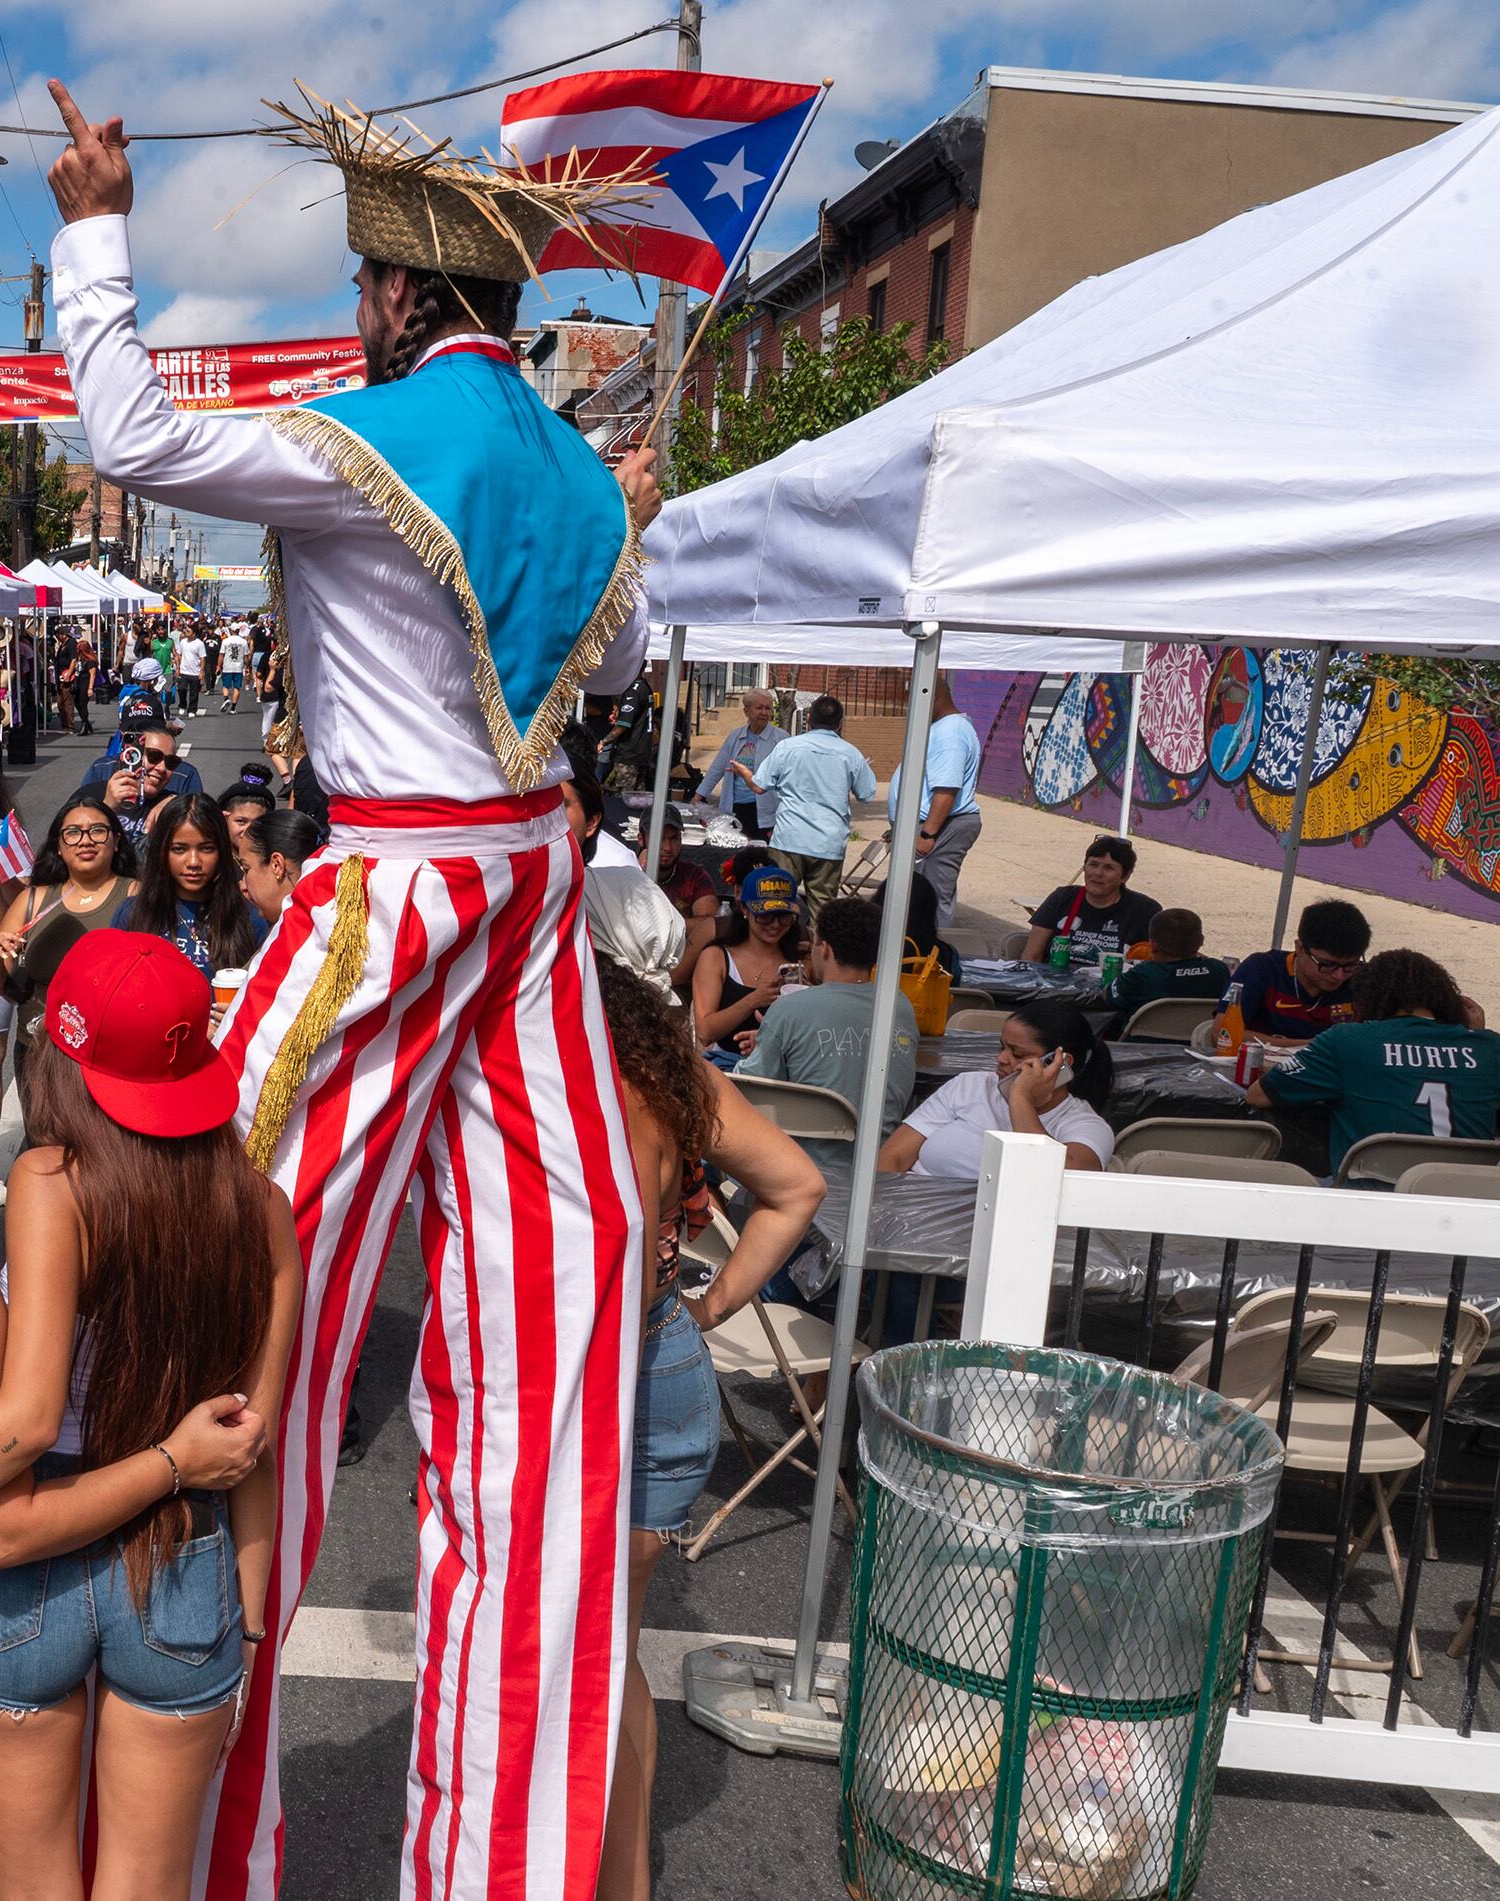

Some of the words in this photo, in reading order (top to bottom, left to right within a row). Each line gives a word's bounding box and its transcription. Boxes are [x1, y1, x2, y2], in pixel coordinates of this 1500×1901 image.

[156, 351, 202, 374] ARTE
[252, 354, 276, 364] FREE
[278, 351, 331, 363] Community
[205, 364, 215, 373] EN
[217, 362, 231, 372] LAS
[161, 373, 231, 400] CALLES
[14, 396, 46, 406] Impacto
[186, 401, 197, 409] DE
[200, 399, 234, 409] VERANO
[1071, 936, 1119, 950] CHAMPIONS
[1383, 1043, 1477, 1069] HURTS
[1413, 1081, 1453, 1138] 1
